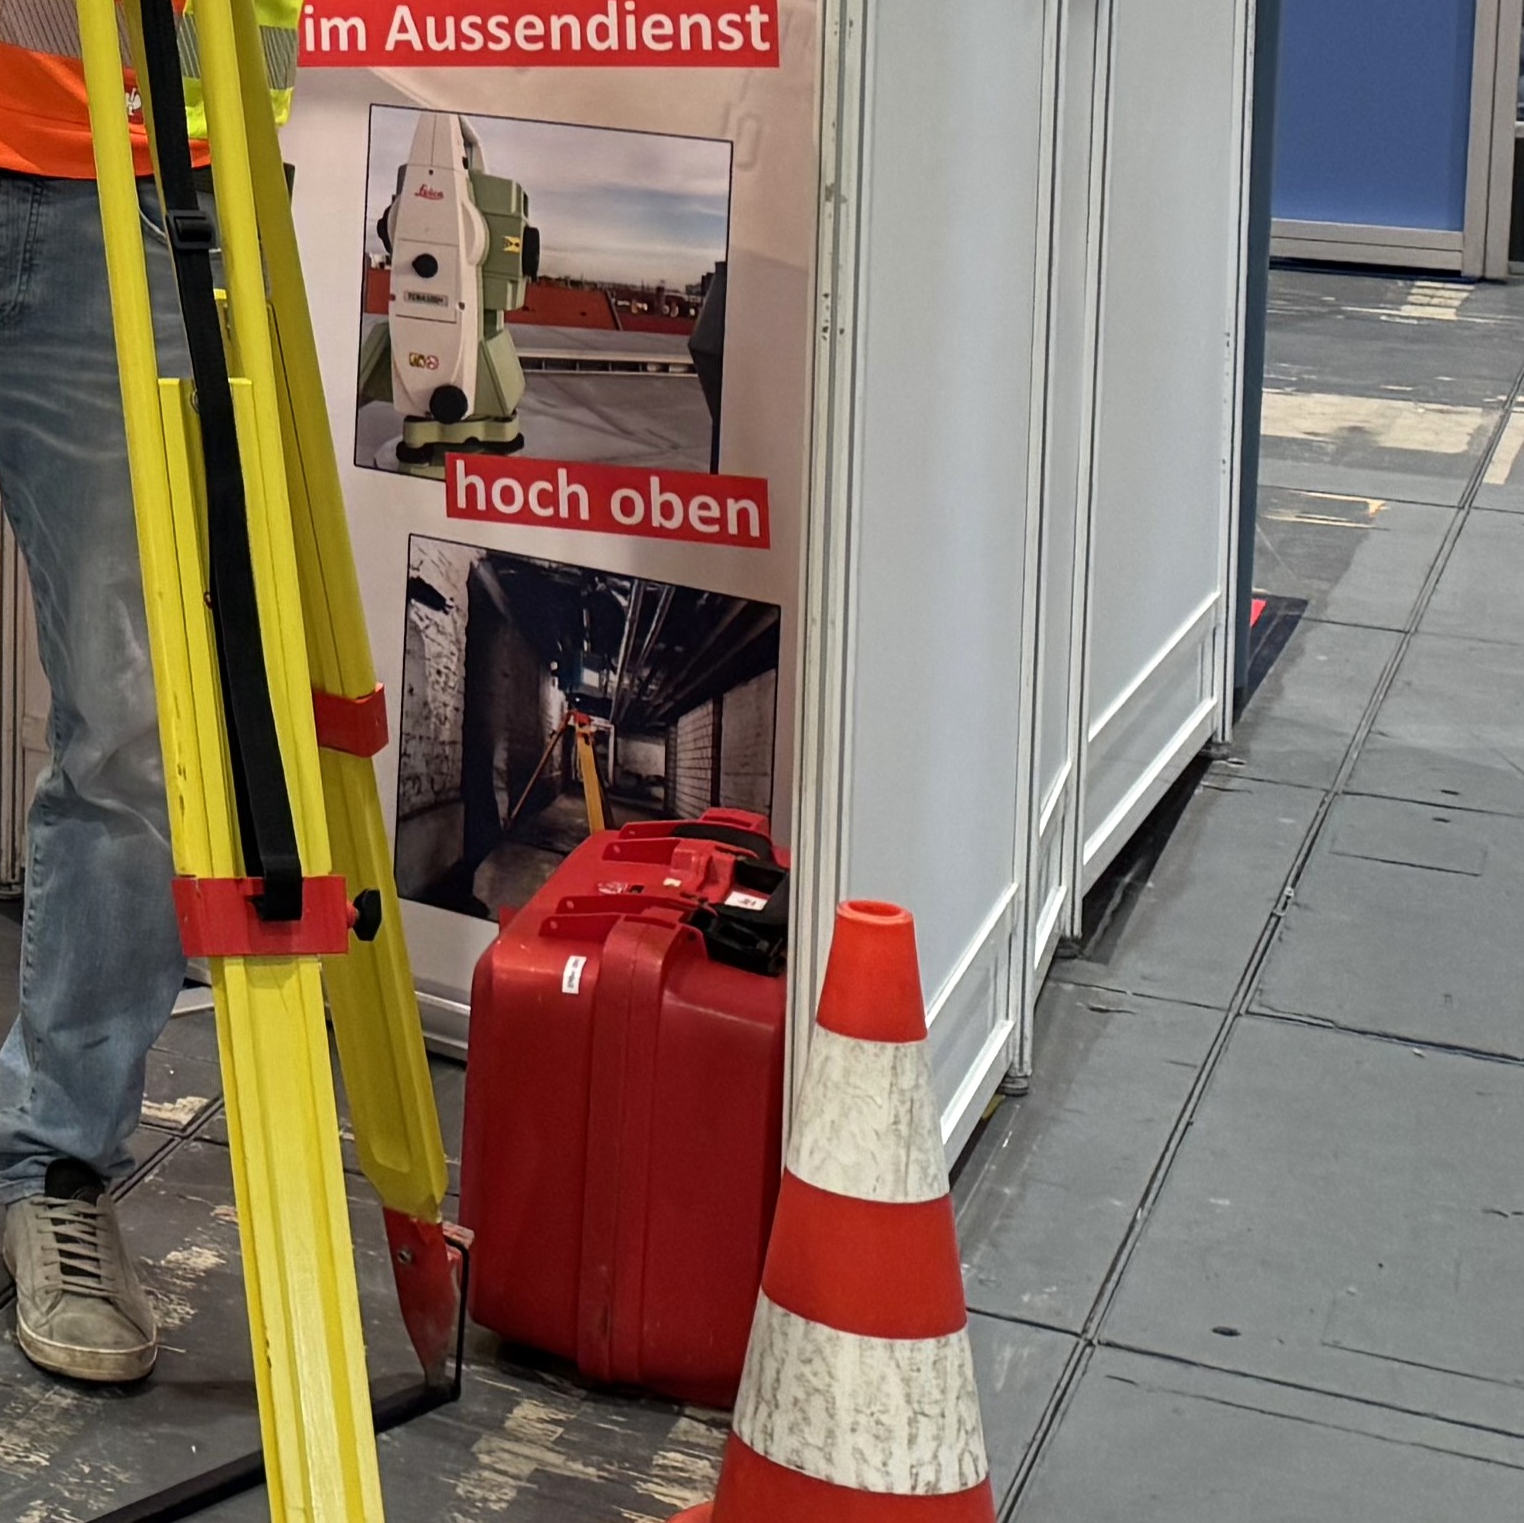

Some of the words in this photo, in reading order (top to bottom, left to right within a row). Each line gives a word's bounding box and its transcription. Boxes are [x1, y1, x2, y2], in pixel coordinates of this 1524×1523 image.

[304, 4, 368, 53] im
[455, 458, 591, 521] hoch
[610, 475, 761, 539] oben
